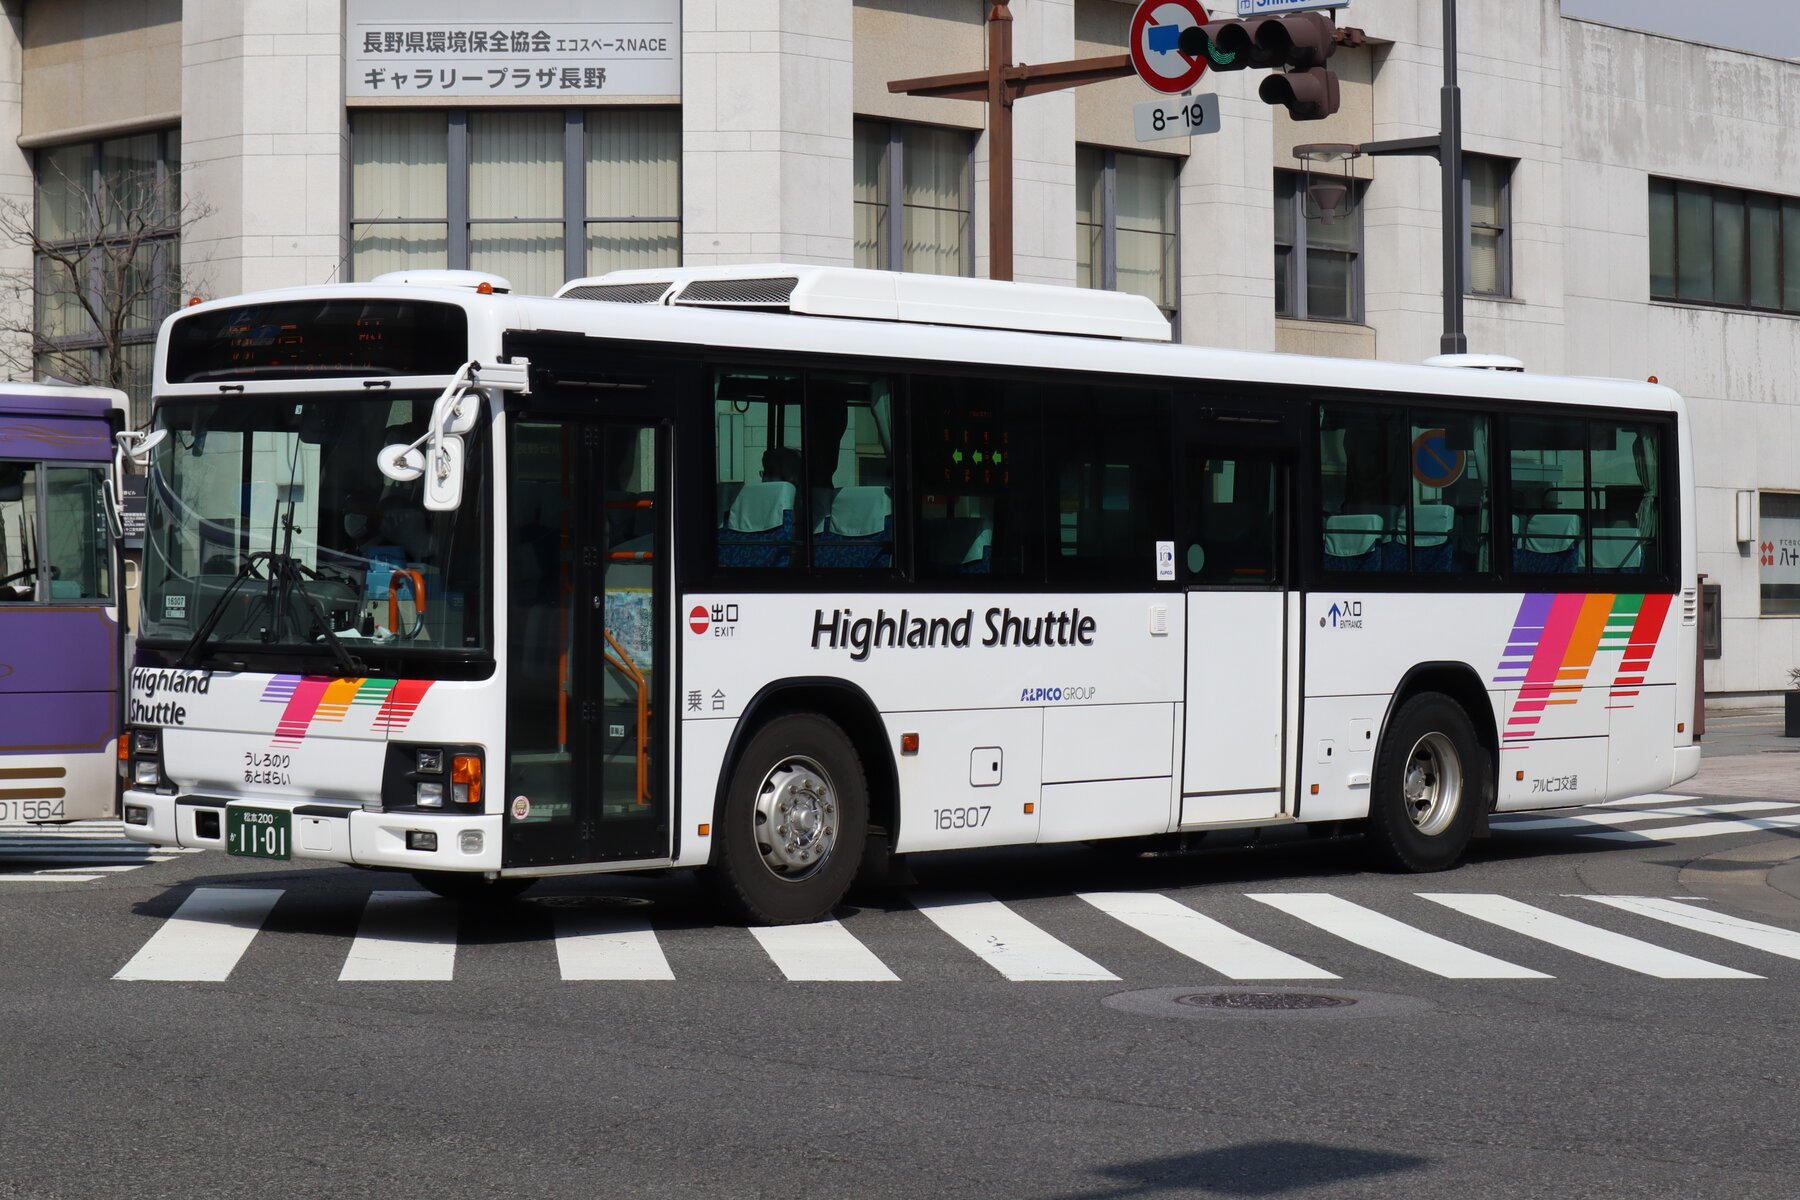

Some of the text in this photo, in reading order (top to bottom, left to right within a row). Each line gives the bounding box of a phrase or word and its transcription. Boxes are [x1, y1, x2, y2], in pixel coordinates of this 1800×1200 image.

[363, 31, 667, 53] 長野県環境保全協会 エコスペースNACE
[364, 67, 607, 90] ギャラリープラザ長野
[1152, 104, 1204, 131] 8-19
[711, 604, 738, 622] 出口
[1342, 601, 1362, 617] 入口
[715, 627, 735, 637] EXIT
[810, 607, 1097, 662] Highland Shuttle
[1340, 620, 1363, 629] ENTRANCE
[132, 668, 213, 697] Highland
[131, 698, 187, 725] Shuttle
[244, 752, 291, 768] うしろのり
[244, 769, 291, 785] あとばらい
[1532, 774, 1578, 793] アルピコ交通
[934, 806, 991, 830] 16307
[241, 823, 285, 856] 11-01
